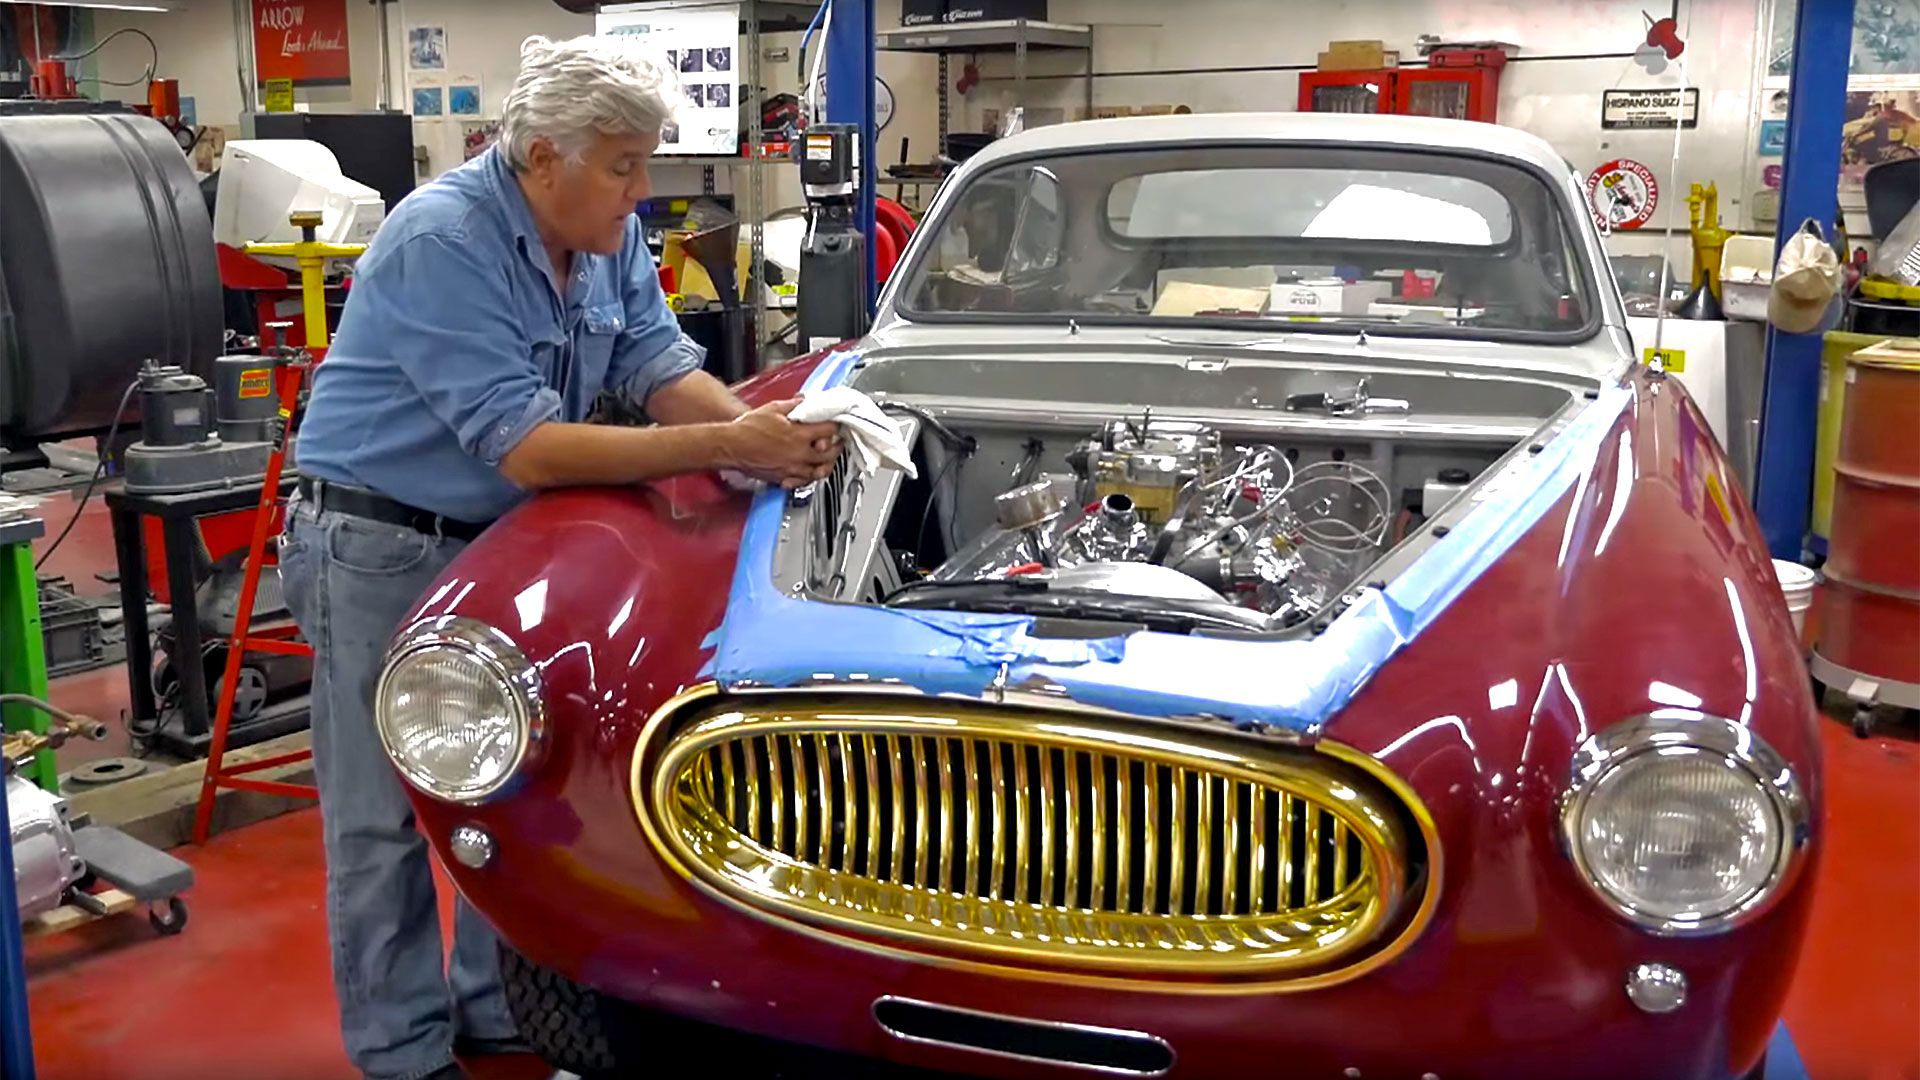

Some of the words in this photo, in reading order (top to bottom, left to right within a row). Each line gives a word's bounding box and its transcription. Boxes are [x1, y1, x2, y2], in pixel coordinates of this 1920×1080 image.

[261, 6, 304, 30] ARROW
[307, 30, 345, 52] Ahead
[1606, 98, 1650, 108] HISPANO
[1618, 160, 1656, 222] SPECIALIZED
